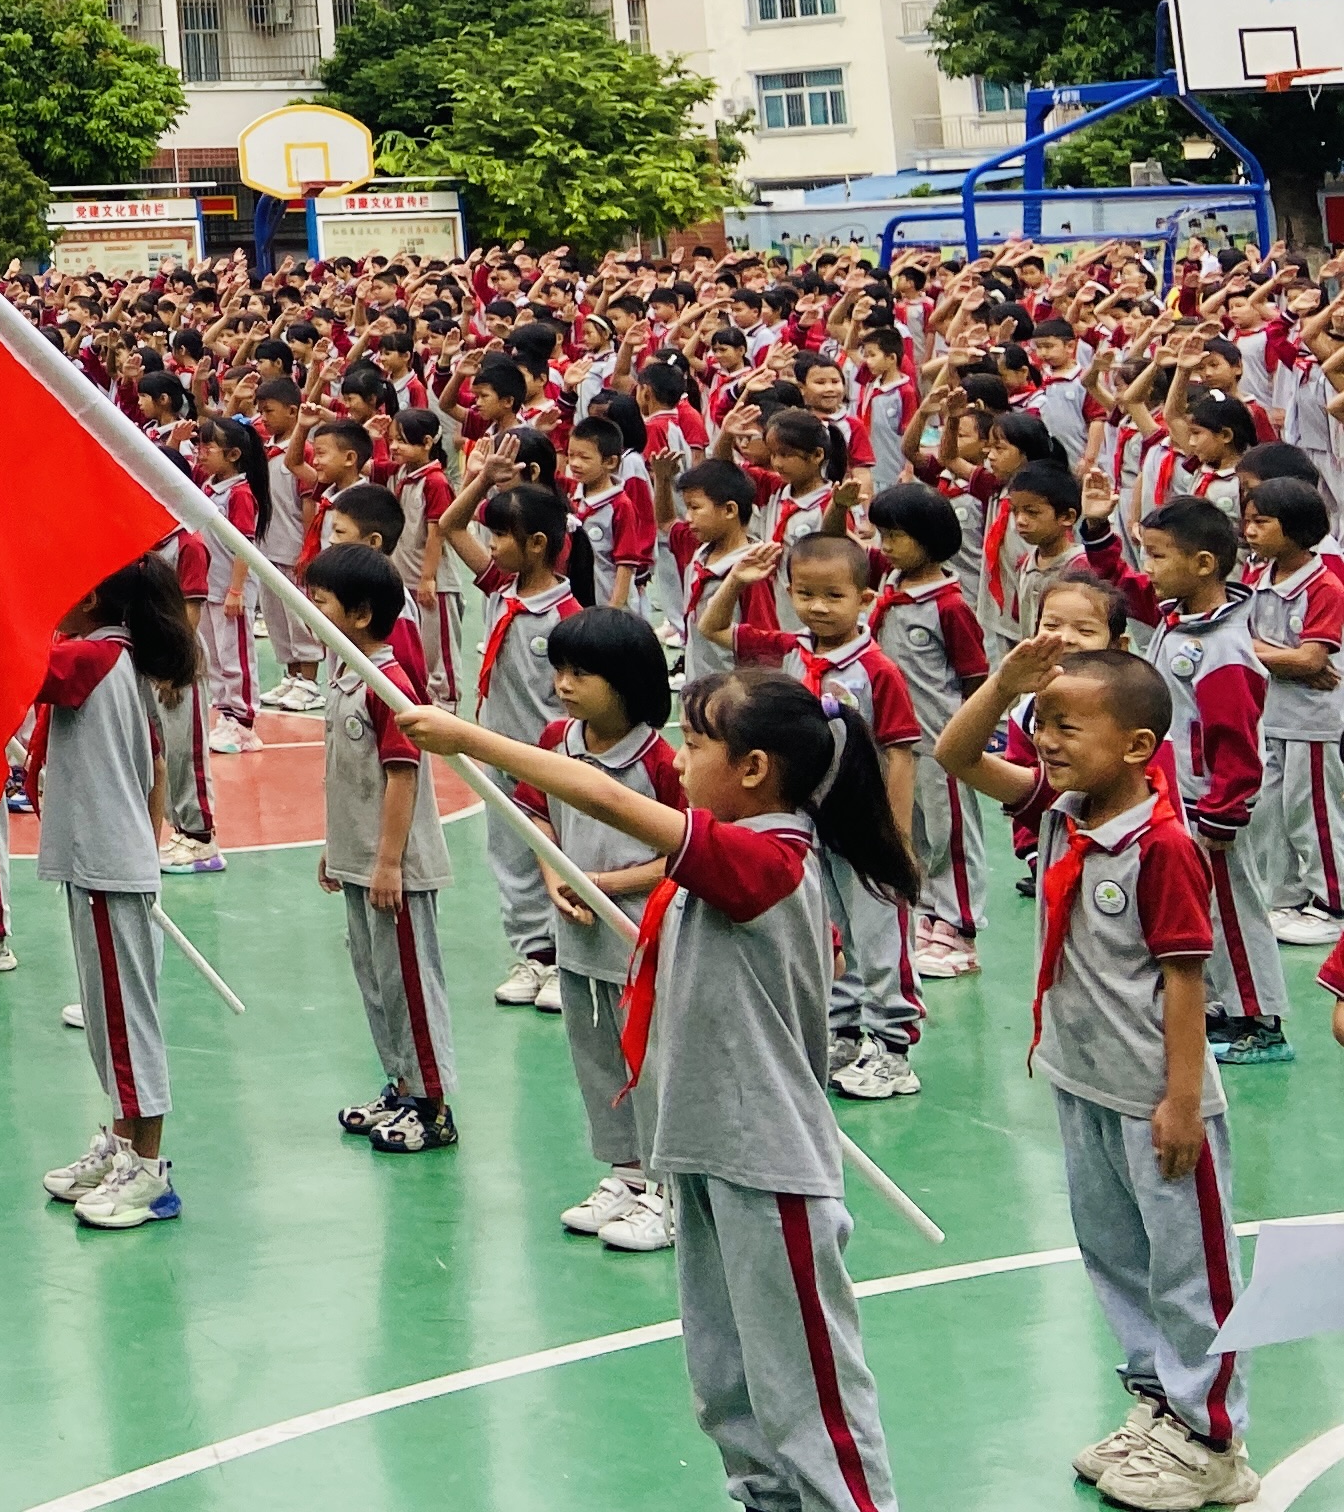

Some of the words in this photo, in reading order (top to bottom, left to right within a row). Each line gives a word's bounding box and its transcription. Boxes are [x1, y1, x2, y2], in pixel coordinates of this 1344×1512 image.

[76, 203, 165, 218] 党建文化宣传栏
